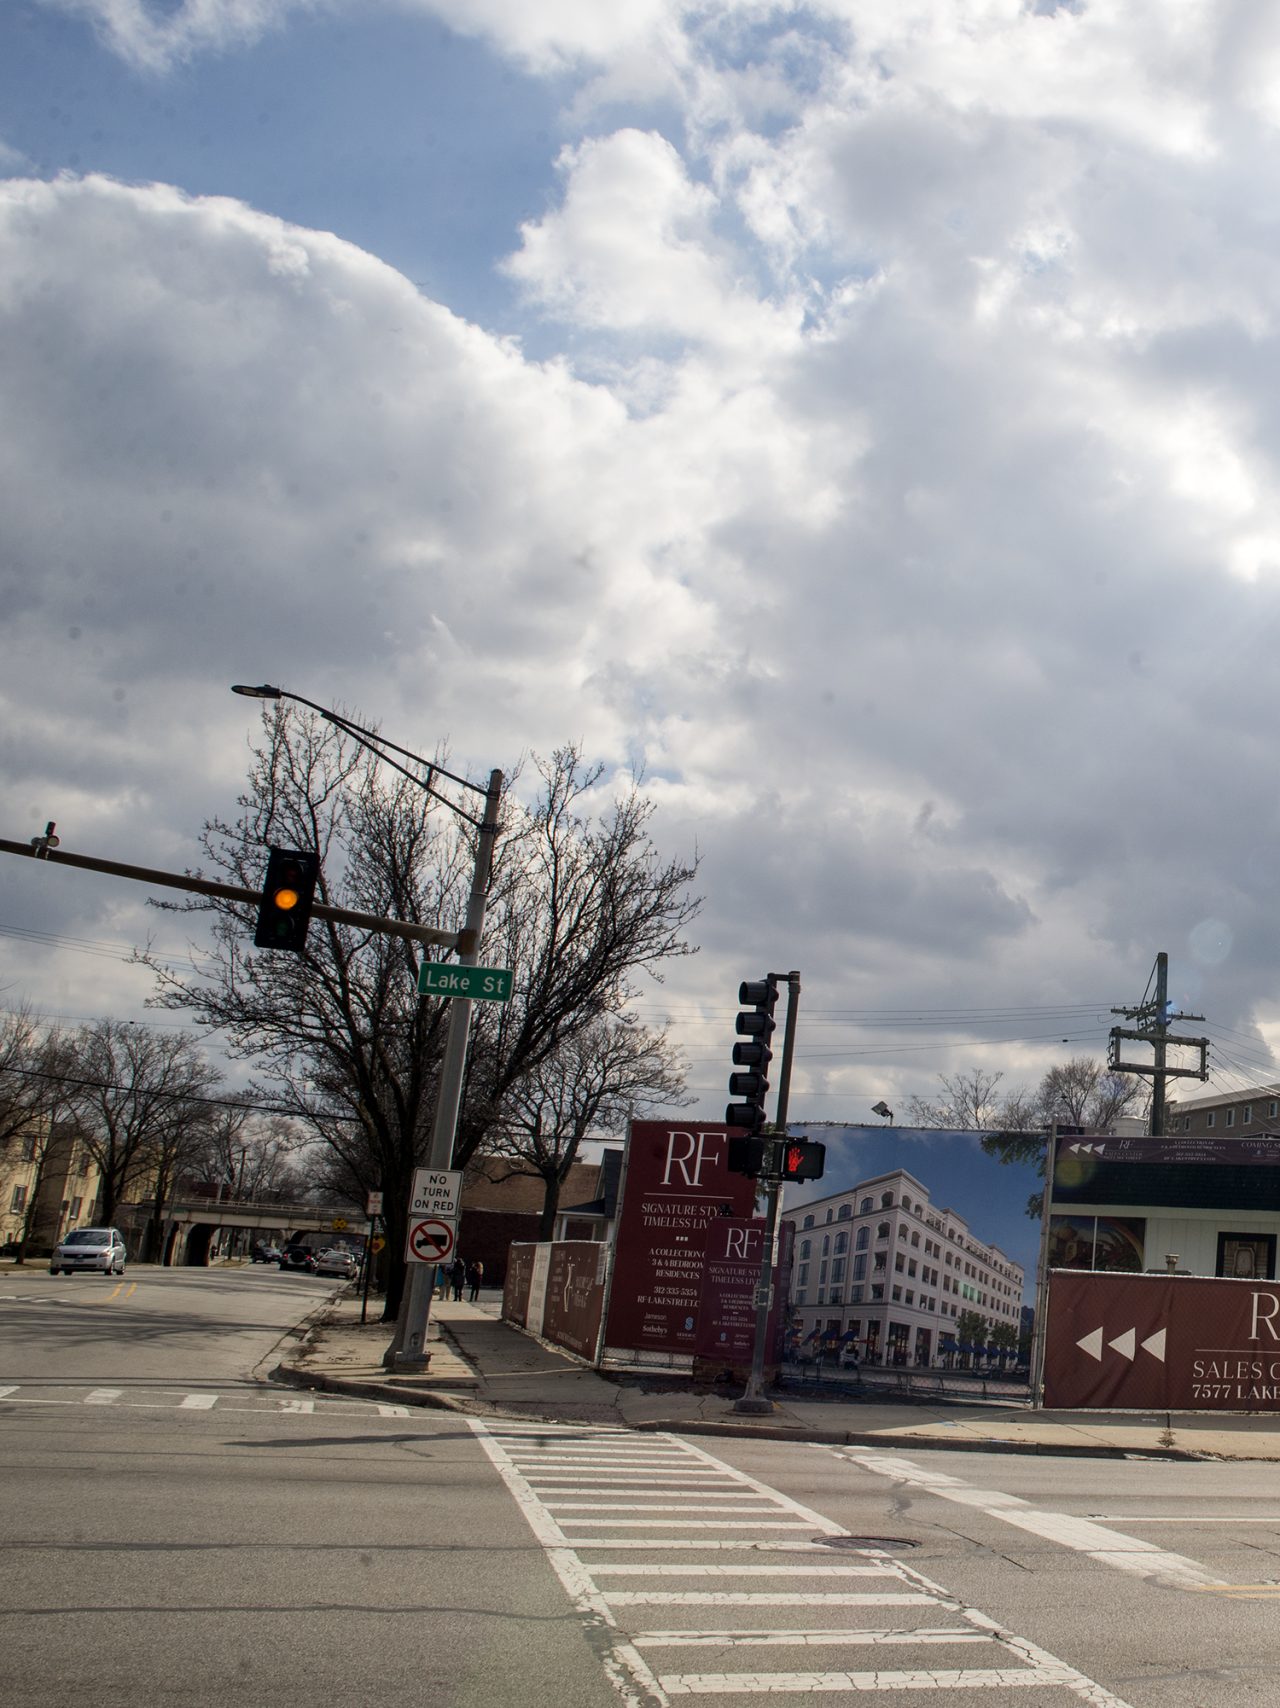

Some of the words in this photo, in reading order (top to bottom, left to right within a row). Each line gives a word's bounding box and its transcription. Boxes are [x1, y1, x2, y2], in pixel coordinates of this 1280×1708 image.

[426, 970, 470, 990] Lake
[482, 976, 504, 994] St
[660, 1131, 727, 1187] RF
[429, 1175, 447, 1185] NO
[423, 1187, 450, 1197] TURN
[415, 1199, 429, 1208] ON
[433, 1200, 454, 1211] RED
[641, 1203, 698, 1216] SIGNATURE
[643, 1215, 691, 1228] TIMELESS
[724, 1227, 762, 1258] RF
[655, 1248, 701, 1258] COLLECTION
[655, 1269, 700, 1279] RESIDENCES
[709, 1266, 747, 1275] SIGNATURE
[711, 1275, 745, 1284] TIMELESS
[637, 1295, 701, 1307] RF-LAKESTREET.C
[1193, 1360, 1262, 1380] SALES
[1192, 1384, 1231, 1399] 7577
